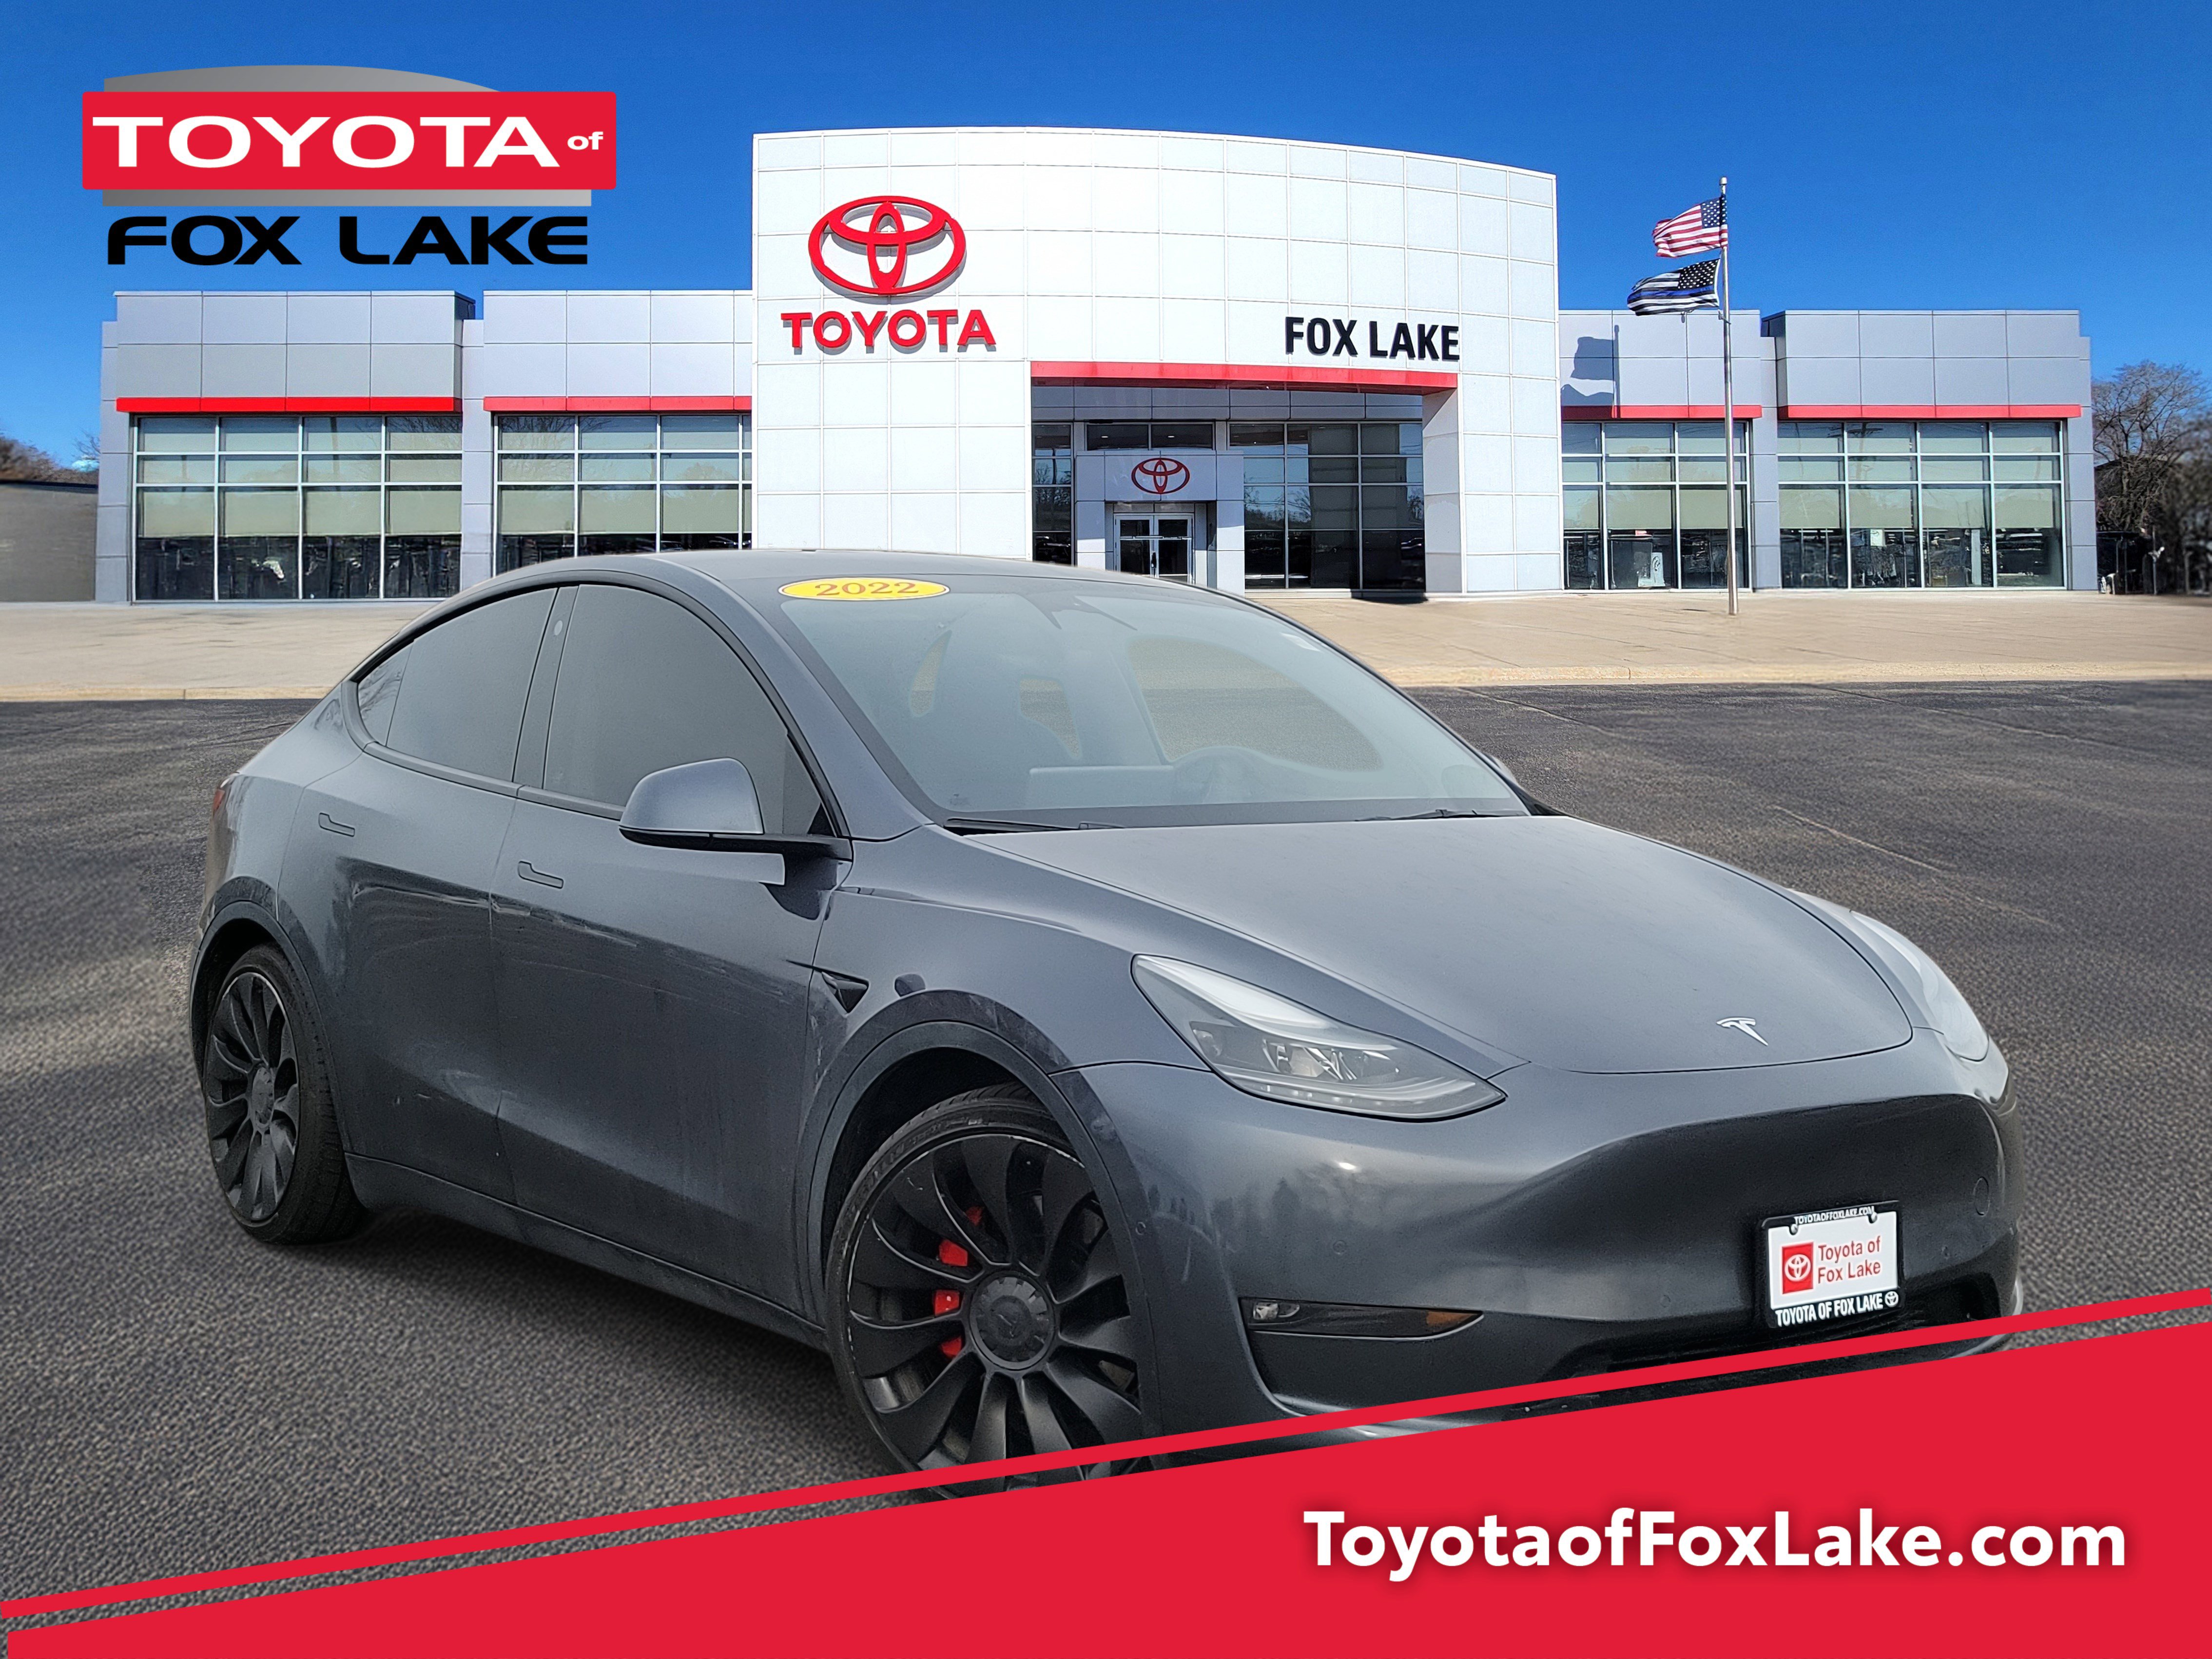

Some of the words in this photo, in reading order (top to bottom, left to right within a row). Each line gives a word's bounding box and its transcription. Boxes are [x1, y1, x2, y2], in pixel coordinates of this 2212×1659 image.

[780, 309, 997, 353] TOYOTA
[1285, 316, 1358, 356] FOX
[1369, 320, 1460, 361] LAKE
[815, 581, 919, 596] 2022
[1818, 1240, 1863, 1263] Toyota
[1867, 1235, 1881, 1252] of
[1818, 1267, 1843, 1284] Fox
[1848, 1260, 1881, 1278] Lake
[1775, 1305, 1817, 1327] TOYOTA
[1818, 1301, 1832, 1319] OF
[1833, 1298, 1855, 1316] FOX
[1856, 1292, 1883, 1312] LAKE
